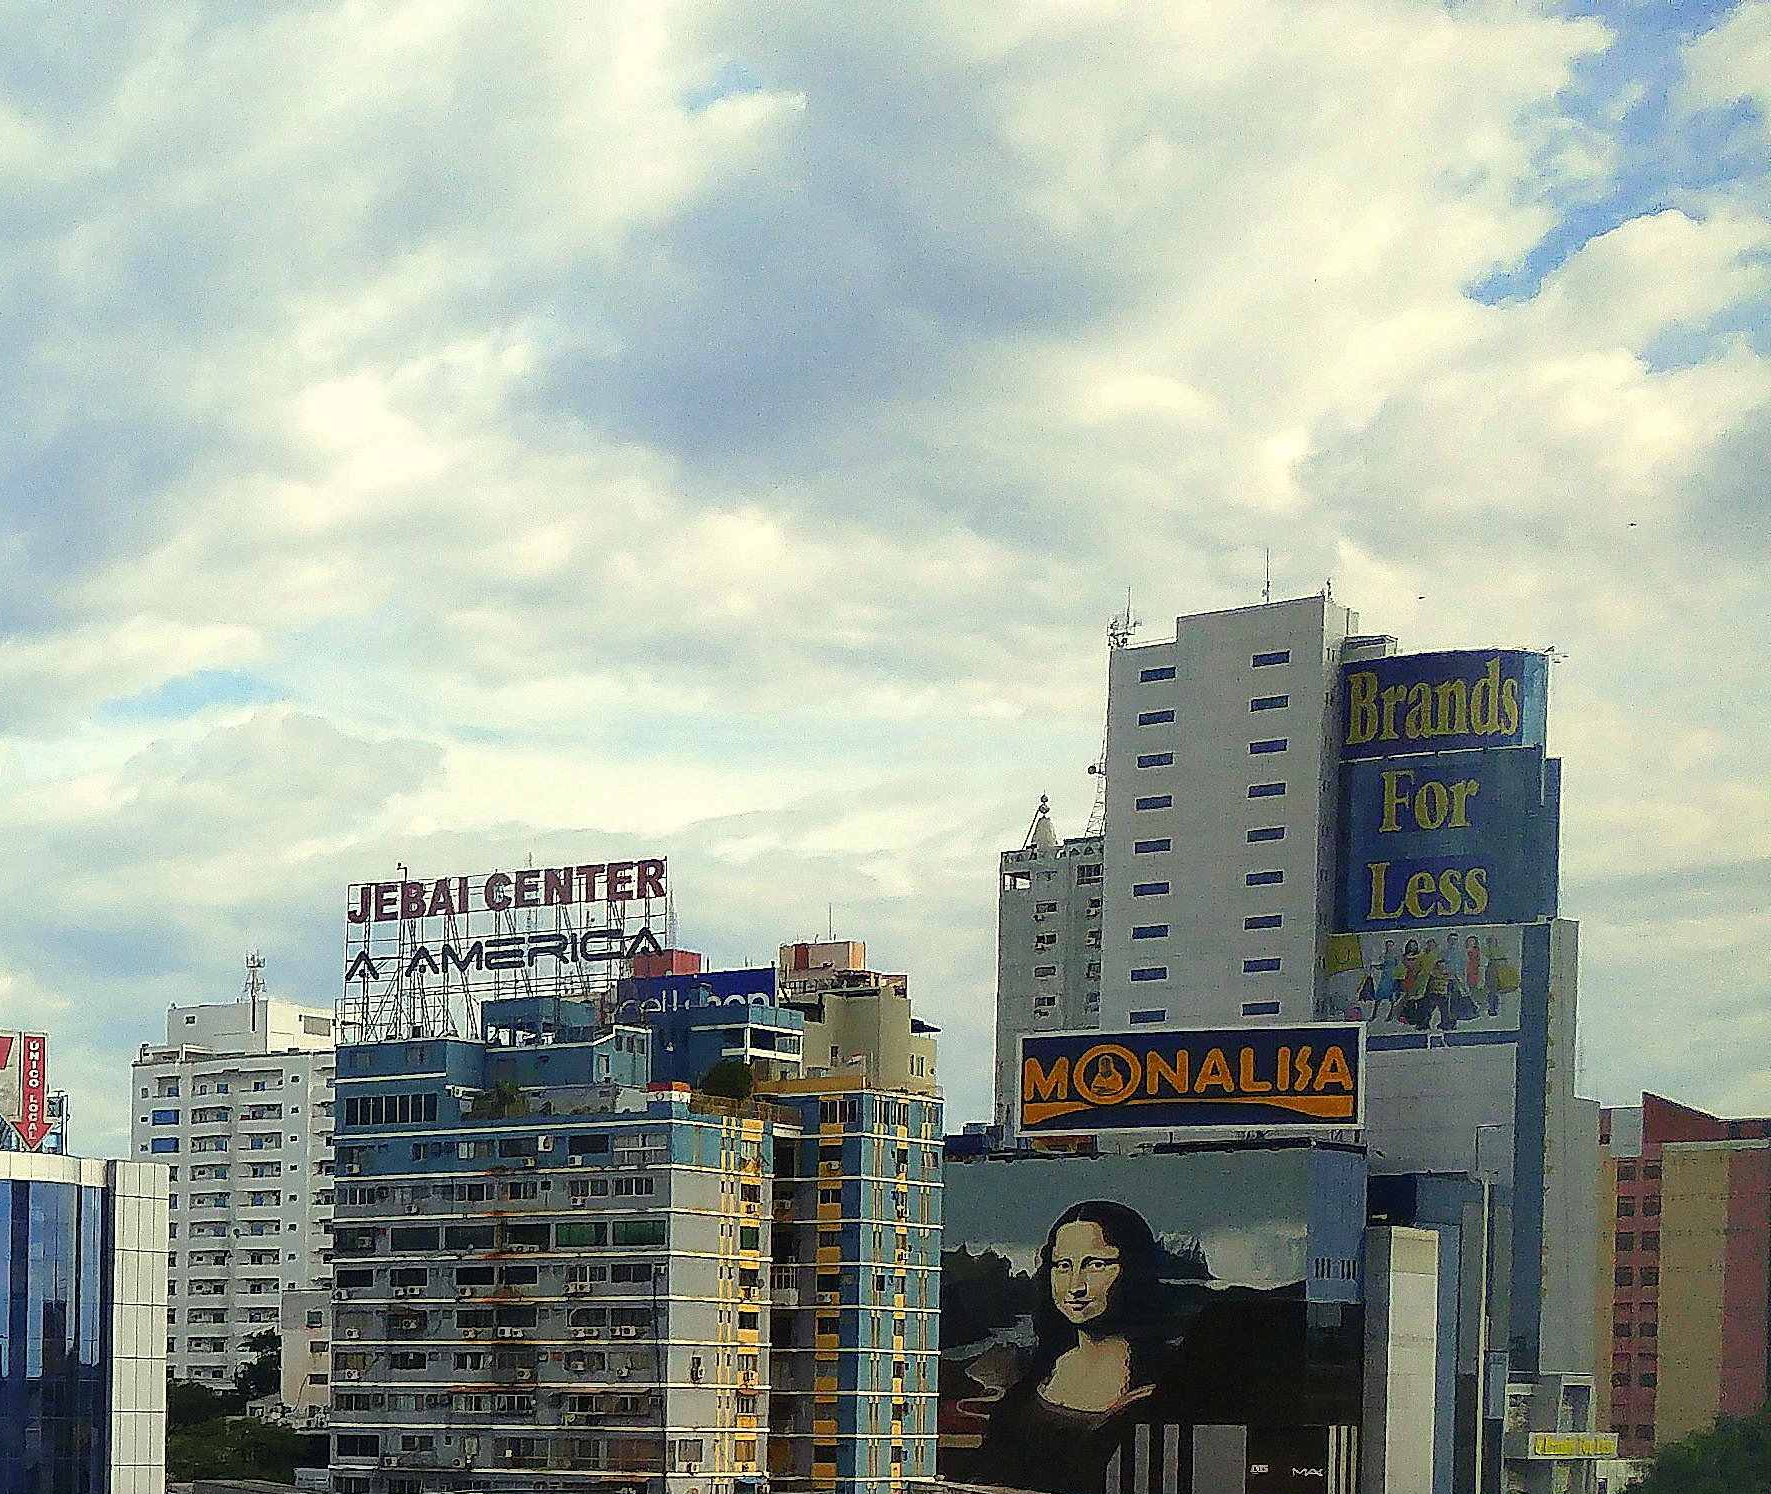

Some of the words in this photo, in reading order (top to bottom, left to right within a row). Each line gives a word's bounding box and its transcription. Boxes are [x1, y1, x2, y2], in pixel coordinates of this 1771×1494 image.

[1345, 657, 1519, 746] Brands
[1379, 769, 1480, 832] For
[348, 877, 469, 924] JEBAI
[485, 859, 667, 911] CENTER
[1366, 860, 1488, 921] Less
[405, 926, 665, 977] AMERICA
[1024, 1044, 1354, 1105] MONALISA
